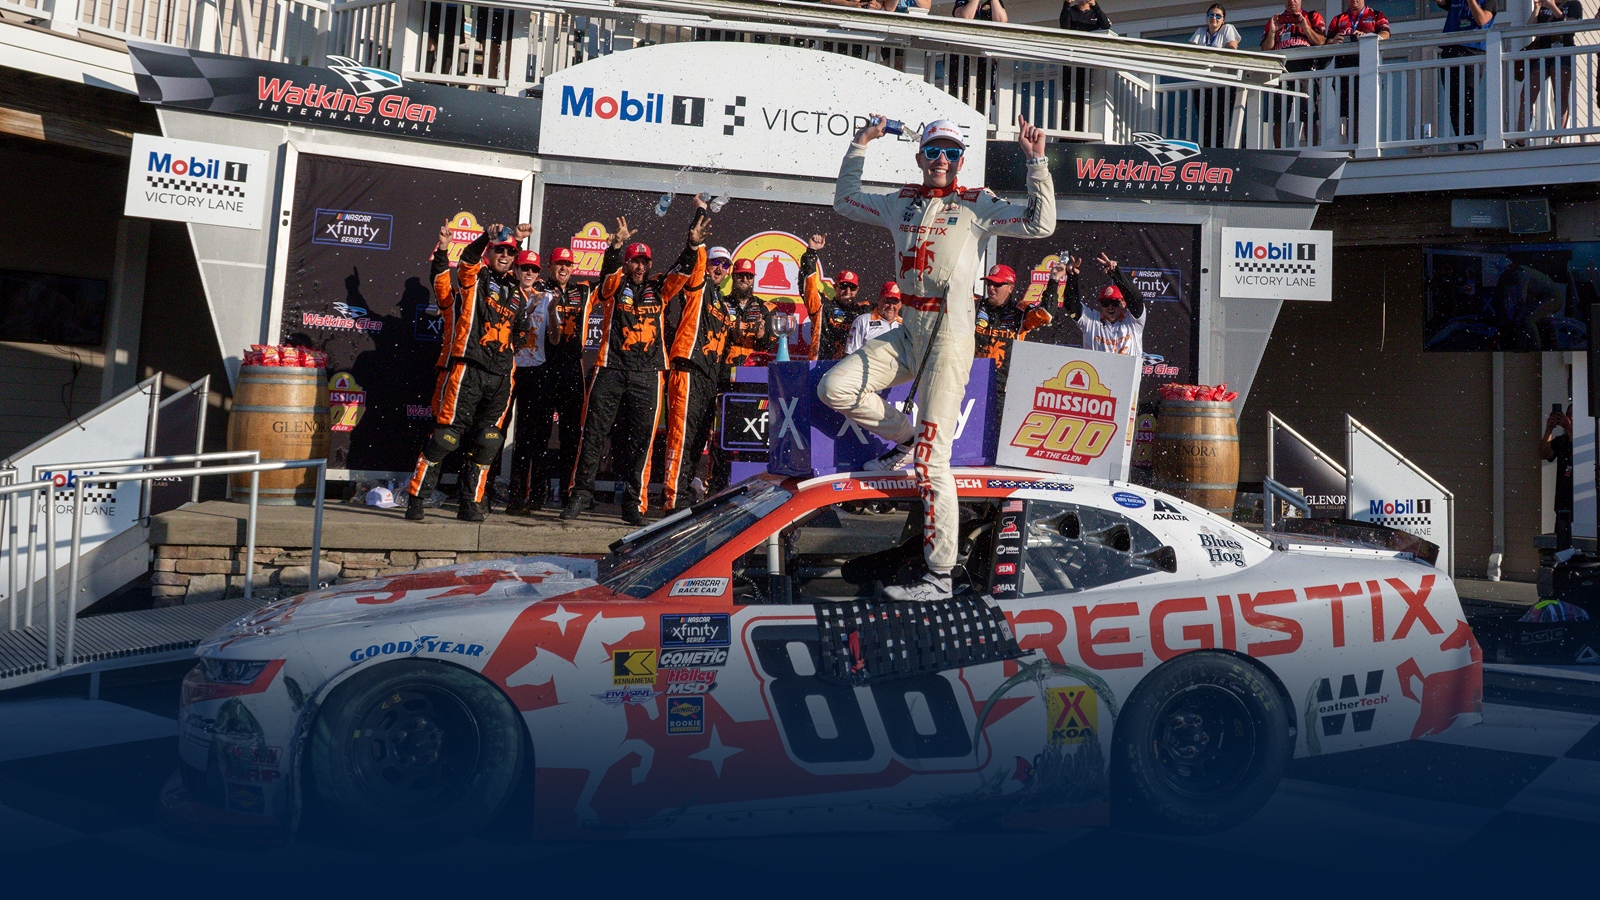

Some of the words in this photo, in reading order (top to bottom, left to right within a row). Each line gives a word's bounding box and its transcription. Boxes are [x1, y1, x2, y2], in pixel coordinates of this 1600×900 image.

[257, 76, 372, 115] Watkins
[378, 94, 437, 124] Glen
[560, 85, 664, 124] Mobil
[258, 102, 432, 133] INTERNATIONAL
[147, 150, 219, 180] Mobil
[1076, 157, 1176, 183] Watkins
[1180, 161, 1234, 185] Glen
[1078, 180, 1231, 193] INTERNATIONAL
[145, 190, 205, 209] VICTORY
[208, 197, 244, 213] LANE
[346, 214, 372, 223] NASCAR
[325, 224, 380, 242] xfinity
[899, 224, 948, 236] REGISTIX
[340, 236, 363, 245] SERIES
[573, 239, 608, 250] MISSIO
[1235, 241, 1292, 260] Mobil
[1138, 270, 1163, 278] NASCAR
[1235, 275, 1283, 287] VICTORY
[1286, 277, 1316, 288] LANE
[302, 313, 355, 329] Watkins
[355, 317, 383, 331] Glen
[1154, 364, 1179, 376] Glen
[331, 391, 364, 402] ISSION
[1036, 392, 1113, 417] MISSION
[1014, 412, 1117, 456] 200
[1033, 449, 1044, 458] AT
[1046, 451, 1060, 461] THE
[1061, 453, 1082, 463] GLEN
[860, 479, 917, 491] CONNOR
[1305, 495, 1347, 505] GLENOR
[1370, 499, 1413, 514] Mobil
[84, 506, 116, 517] LANE
[1153, 513, 1189, 522] AXALTA
[1197, 533, 1244, 551] Blues
[1207, 548, 1245, 568] Hog
[998, 565, 1013, 573] SEM
[689, 579, 721, 587] NASCAR
[672, 624, 719, 641] xfinity
[1002, 574, 1444, 678] REGISTIX
[660, 650, 727, 665] COMETIC
[614, 677, 655, 686] KENNAMETAL
[667, 669, 716, 685] Holley
[605, 691, 624, 699] FIVE
[665, 683, 712, 695] MSD
[1052, 727, 1092, 740] KOA
